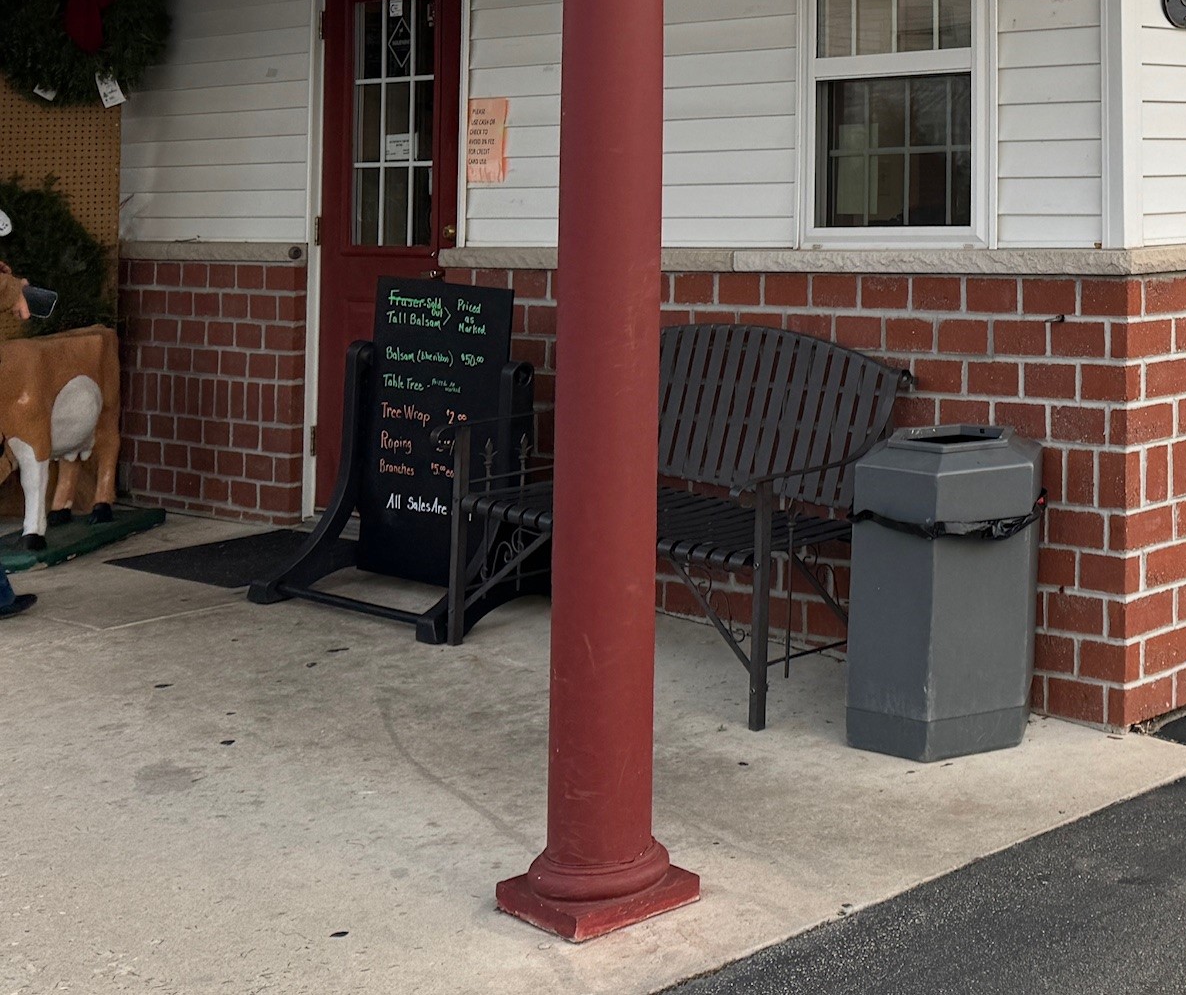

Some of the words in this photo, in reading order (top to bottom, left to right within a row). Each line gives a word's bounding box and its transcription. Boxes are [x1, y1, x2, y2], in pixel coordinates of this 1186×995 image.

[457, 298, 482, 314] Priced
[386, 310, 407, 324] Tall
[409, 313, 442, 331] Balsam
[464, 316, 475, 324] as
[386, 345, 416, 363] Balsam
[382, 373, 405, 390] Table
[406, 377, 425, 392] Tree
[381, 401, 402, 419] Tree
[403, 404, 431, 428] Wrap
[380, 429, 412, 455] Roping
[379, 458, 415, 477] Branches
[386, 492, 401, 510] All
[406, 495, 431, 513] Sales
[430, 497, 448, 516] Are
